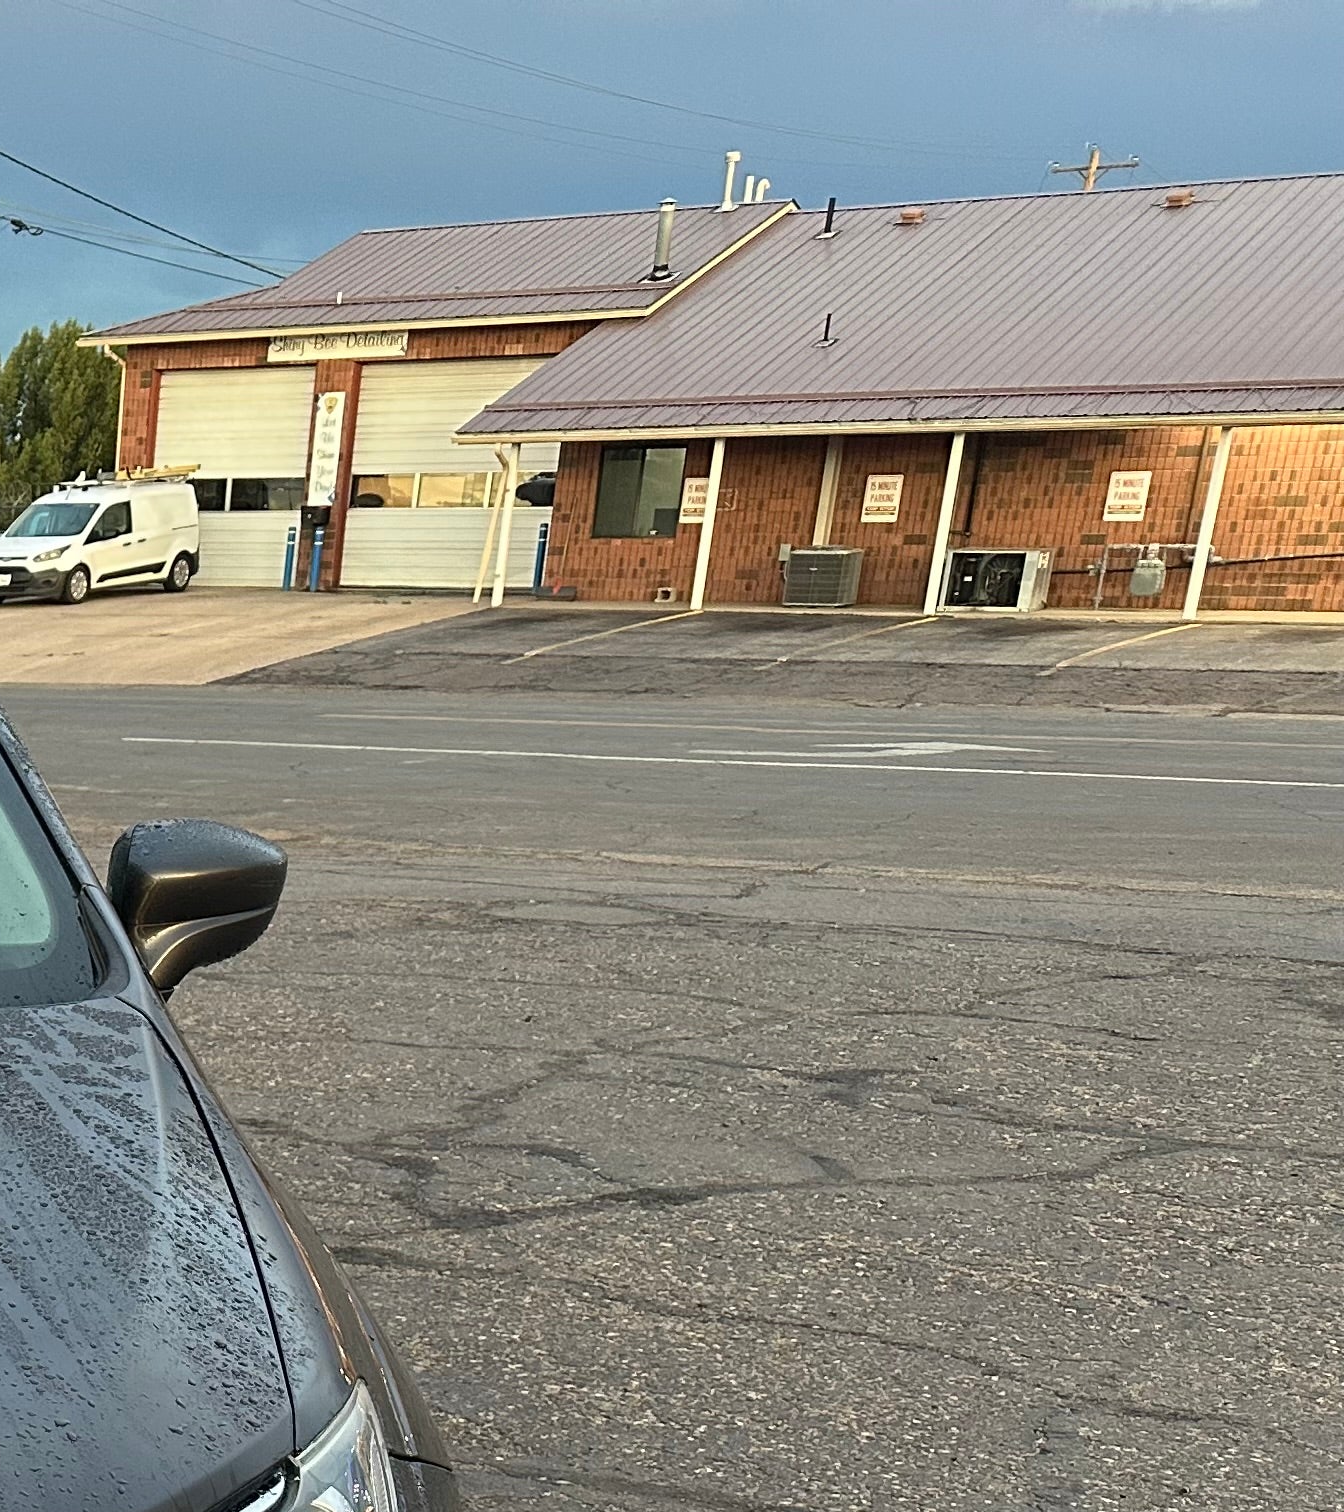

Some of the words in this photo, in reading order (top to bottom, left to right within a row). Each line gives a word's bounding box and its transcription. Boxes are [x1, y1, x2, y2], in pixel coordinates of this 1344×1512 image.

[272, 335, 305, 356] Shiny
[308, 333, 338, 350] Bee
[340, 330, 405, 348] Detailing
